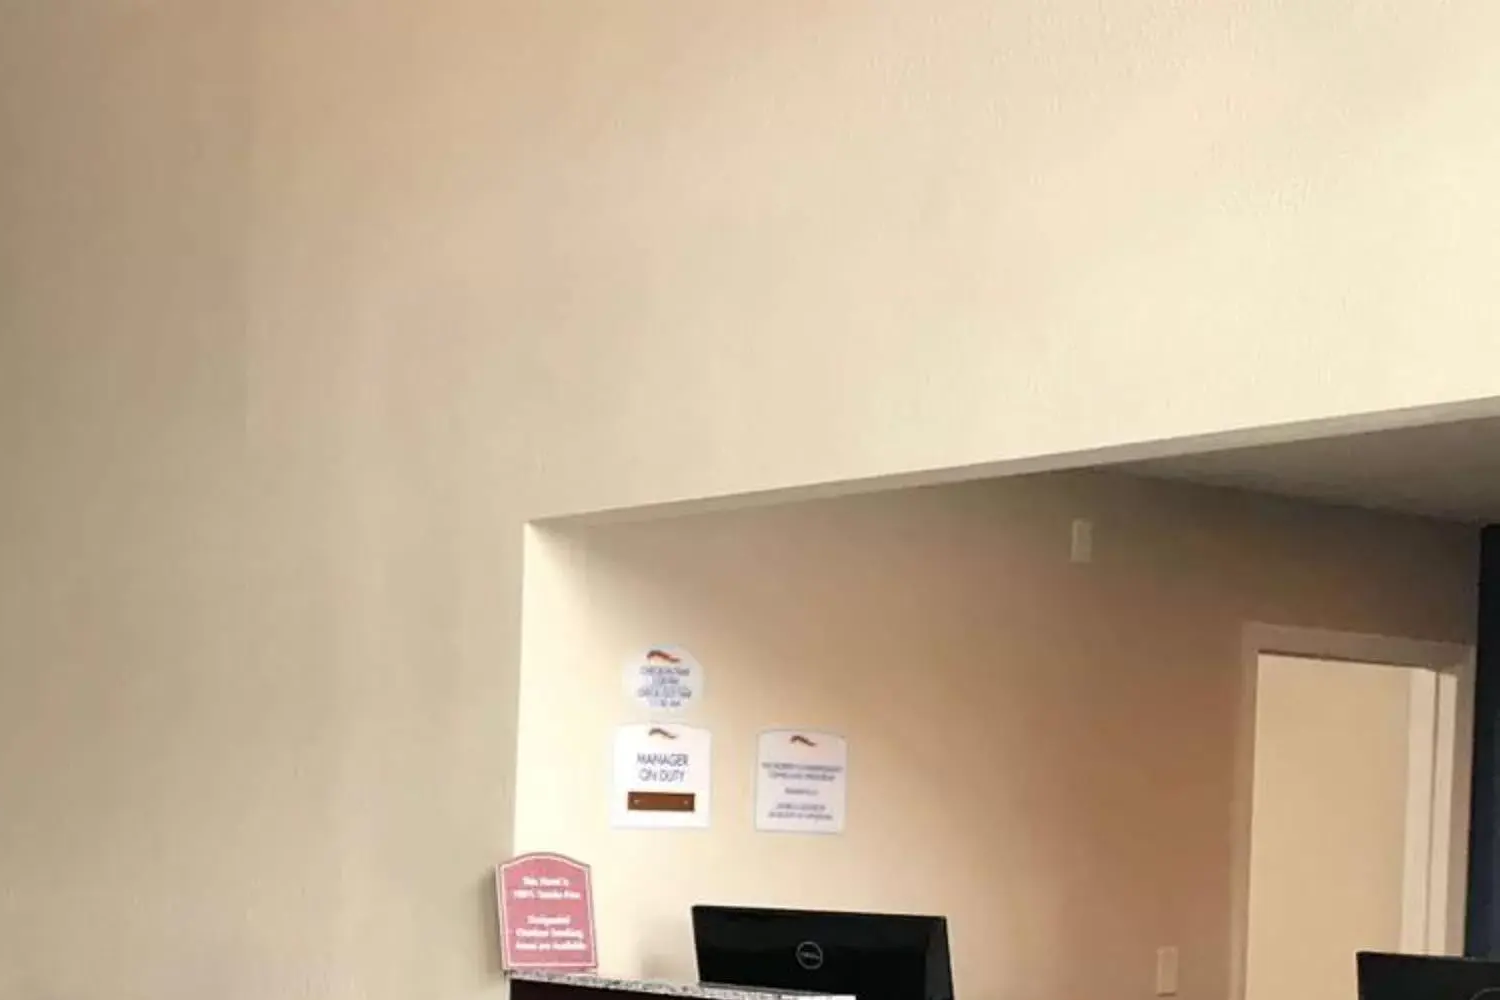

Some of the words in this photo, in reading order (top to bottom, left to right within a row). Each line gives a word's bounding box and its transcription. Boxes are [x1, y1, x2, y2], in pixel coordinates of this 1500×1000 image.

[636, 752, 688, 767] MANAGER
[639, 768, 657, 782] ON
[659, 769, 685, 783] DUTY
